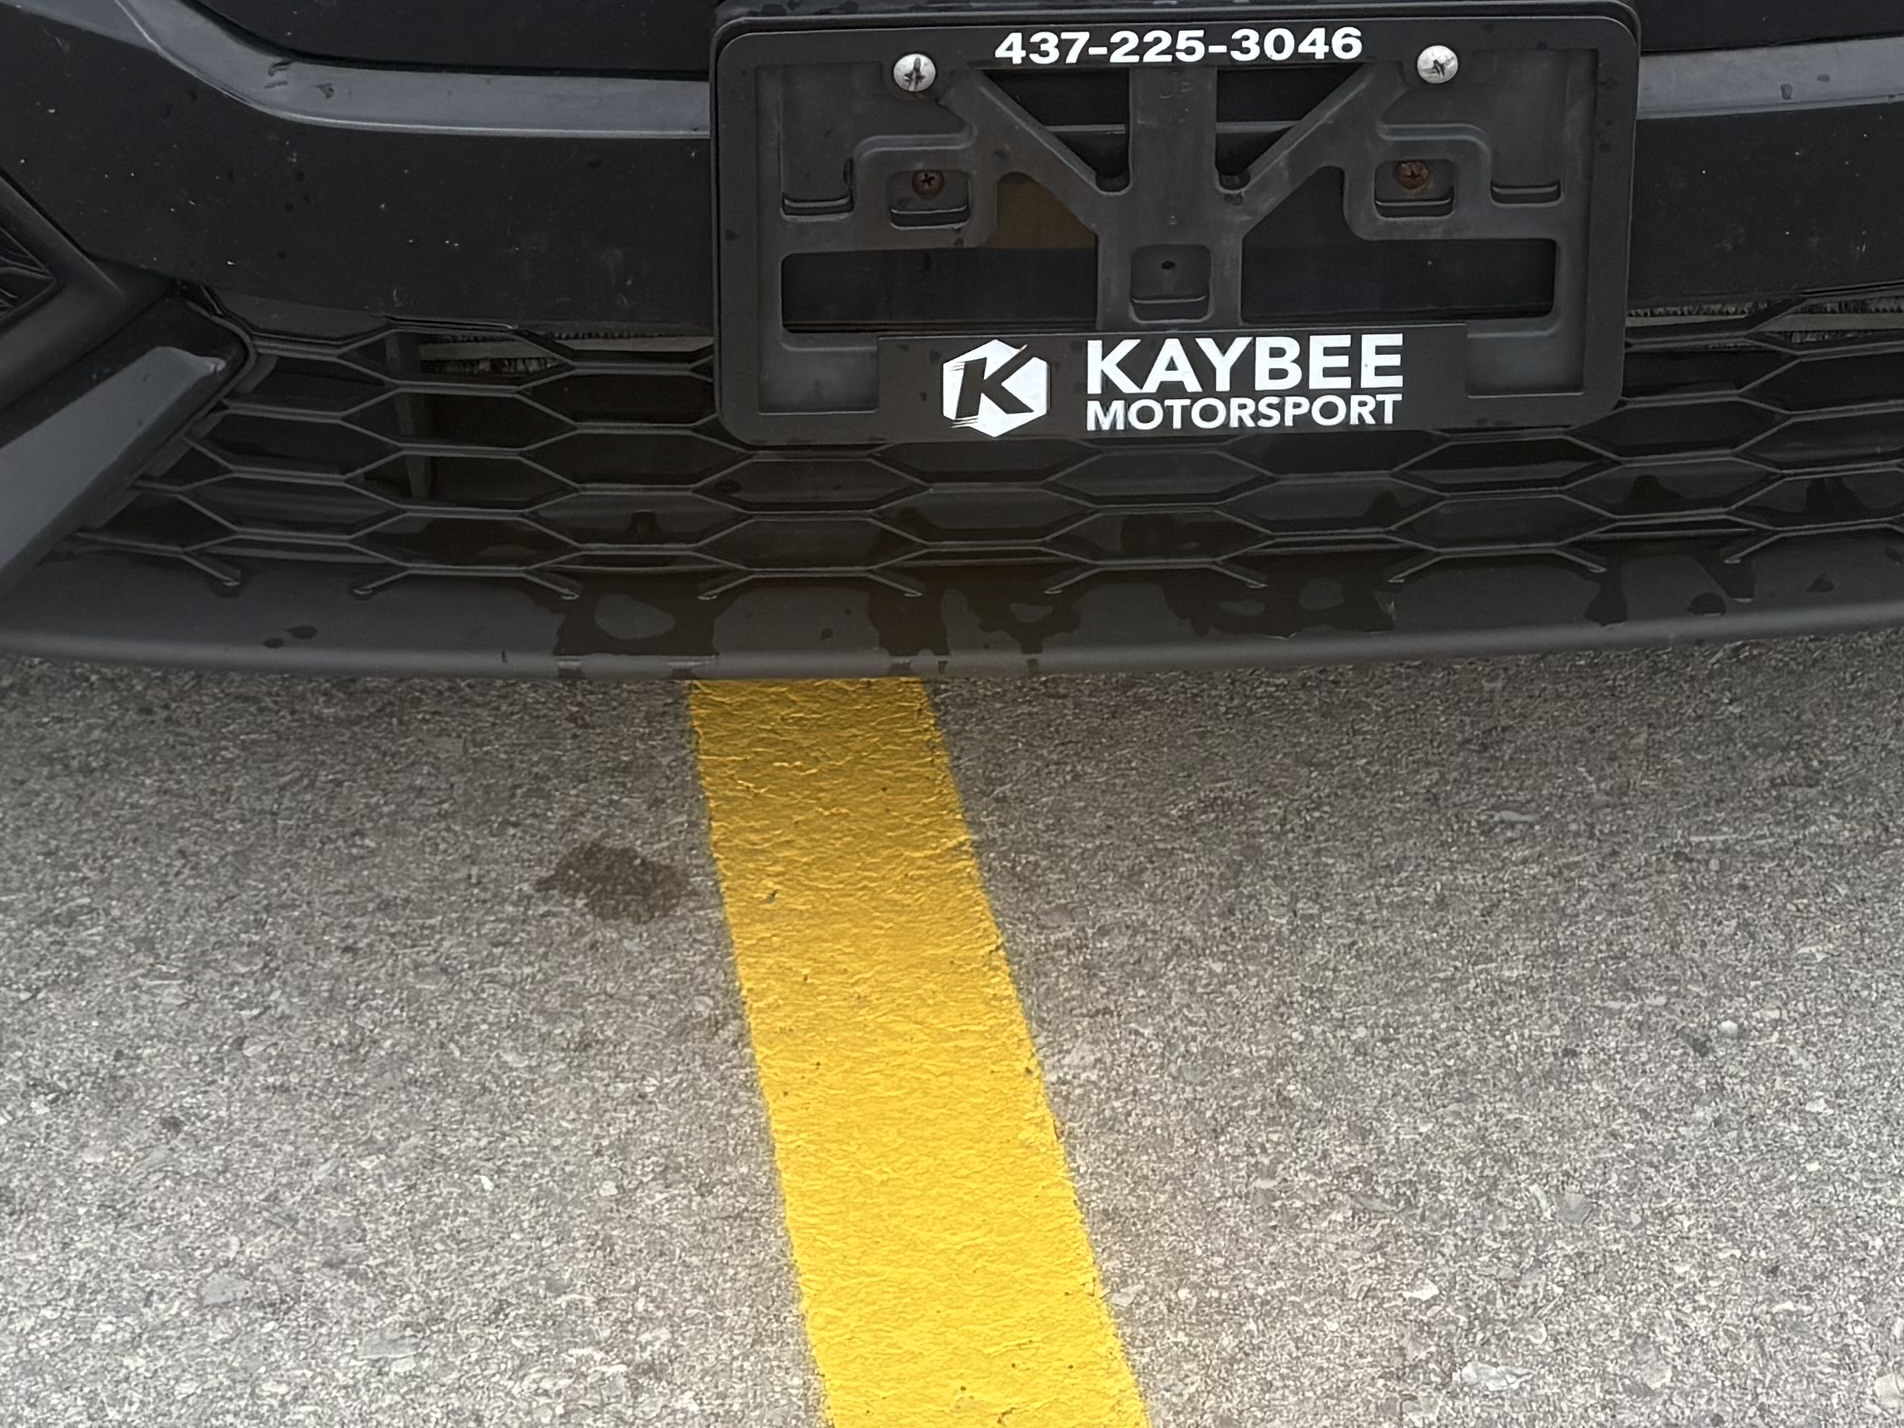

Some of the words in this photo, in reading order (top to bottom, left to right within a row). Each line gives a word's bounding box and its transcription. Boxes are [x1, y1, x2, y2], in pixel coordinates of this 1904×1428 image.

[994, 26, 1363, 65] 437-225-3046
[1086, 333, 1404, 394] KAYBEE
[1086, 394, 1403, 432] MOTORSPORT
